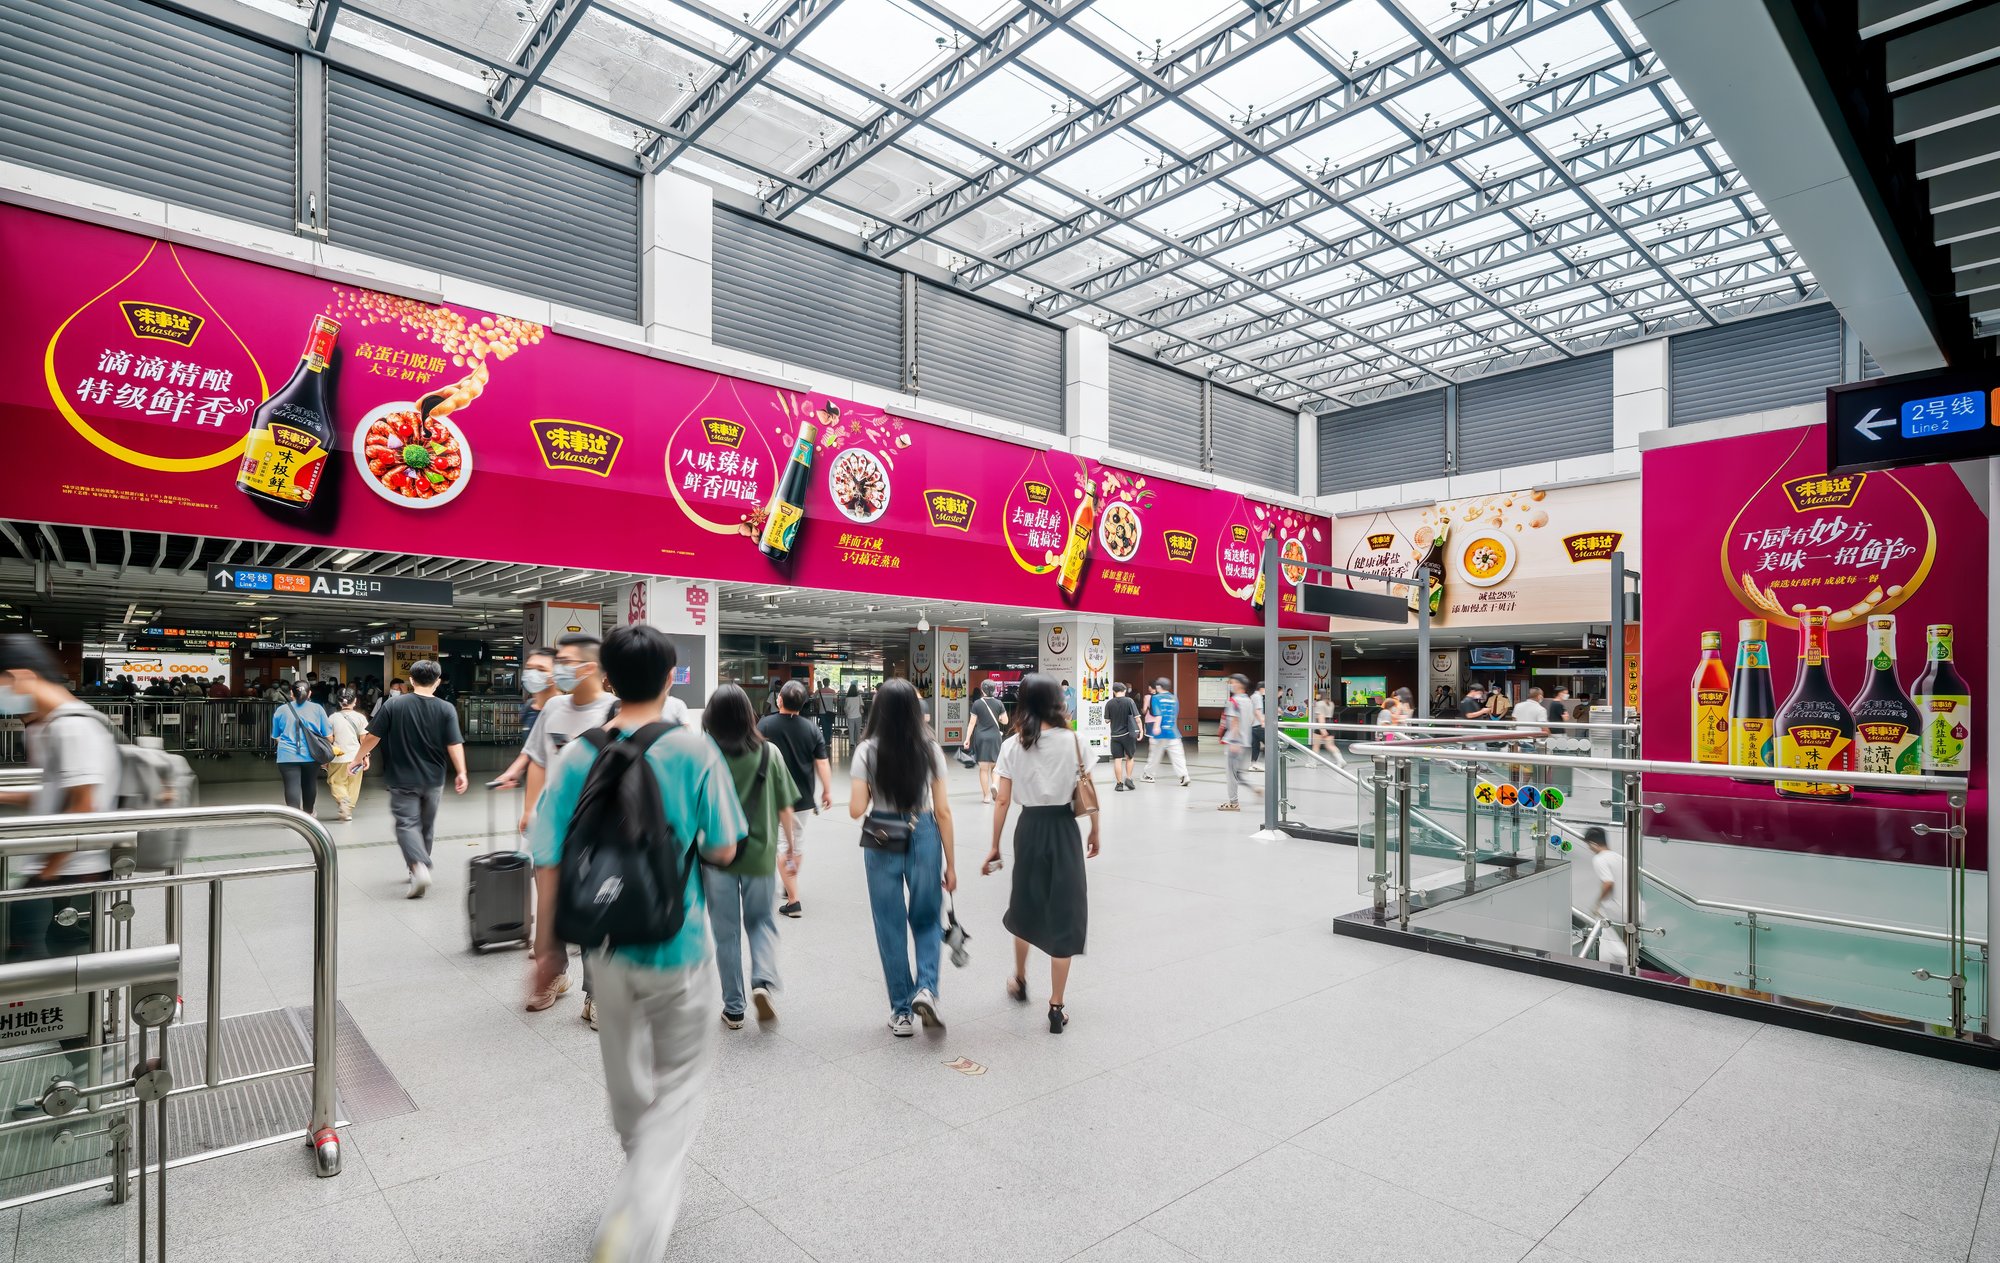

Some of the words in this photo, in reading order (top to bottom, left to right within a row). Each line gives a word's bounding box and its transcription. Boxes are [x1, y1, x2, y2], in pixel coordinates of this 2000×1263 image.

[133, 308, 193, 331] 味事达
[139, 325, 188, 339] Master
[355, 342, 447, 374] 高蛋白脱脂
[97, 348, 234, 393] 滴滴精酿
[367, 362, 431, 384] 大豆初榨
[76, 376, 238, 428] 特级鲜香
[1912, 396, 1975, 420] 2号线
[708, 422, 739, 437] 味事达
[1912, 423, 1938, 434] Line
[1942, 419, 1949, 430] 2
[546, 427, 609, 455] 味事达
[551, 450, 605, 465] Master
[676, 448, 760, 479] 八味臻材
[267, 450, 296, 493] 味极鲜
[682, 471, 759, 501] 鲜香四溢
[1795, 477, 1851, 497] 味事达
[932, 495, 969, 515] 味事达
[1800, 493, 1847, 505] Master
[1012, 506, 1061, 533] 去腥提鲜
[838, 532, 884, 551] 鲜而不咸
[1017, 529, 1062, 549] 一瓶搞定
[1169, 534, 1193, 550] 味事达
[1740, 515, 1873, 551] 下厨有妙方
[1571, 535, 1613, 551] 味事达
[841, 551, 901, 569] 3勺搞定蒸鱼
[1354, 552, 1401, 570] 健康减盐
[1574, 549, 1611, 558] Master
[1754, 537, 1908, 573] 美味一招鲜
[240, 573, 268, 583] 2号线
[1225, 563, 1256, 580] 慢火熬制
[279, 576, 306, 586] 3号线
[311, 576, 355, 596] A.B
[355, 580, 381, 592] 出口
[1770, 577, 1822, 588] 臻选好原料
[1824, 574, 1880, 585] 成就每一餐
[1193, 637, 1205, 647] A.B
[1797, 730, 1832, 740] 味事达
[1864, 726, 1901, 736] 味事达
[31, 1024, 63, 1035] Metro
